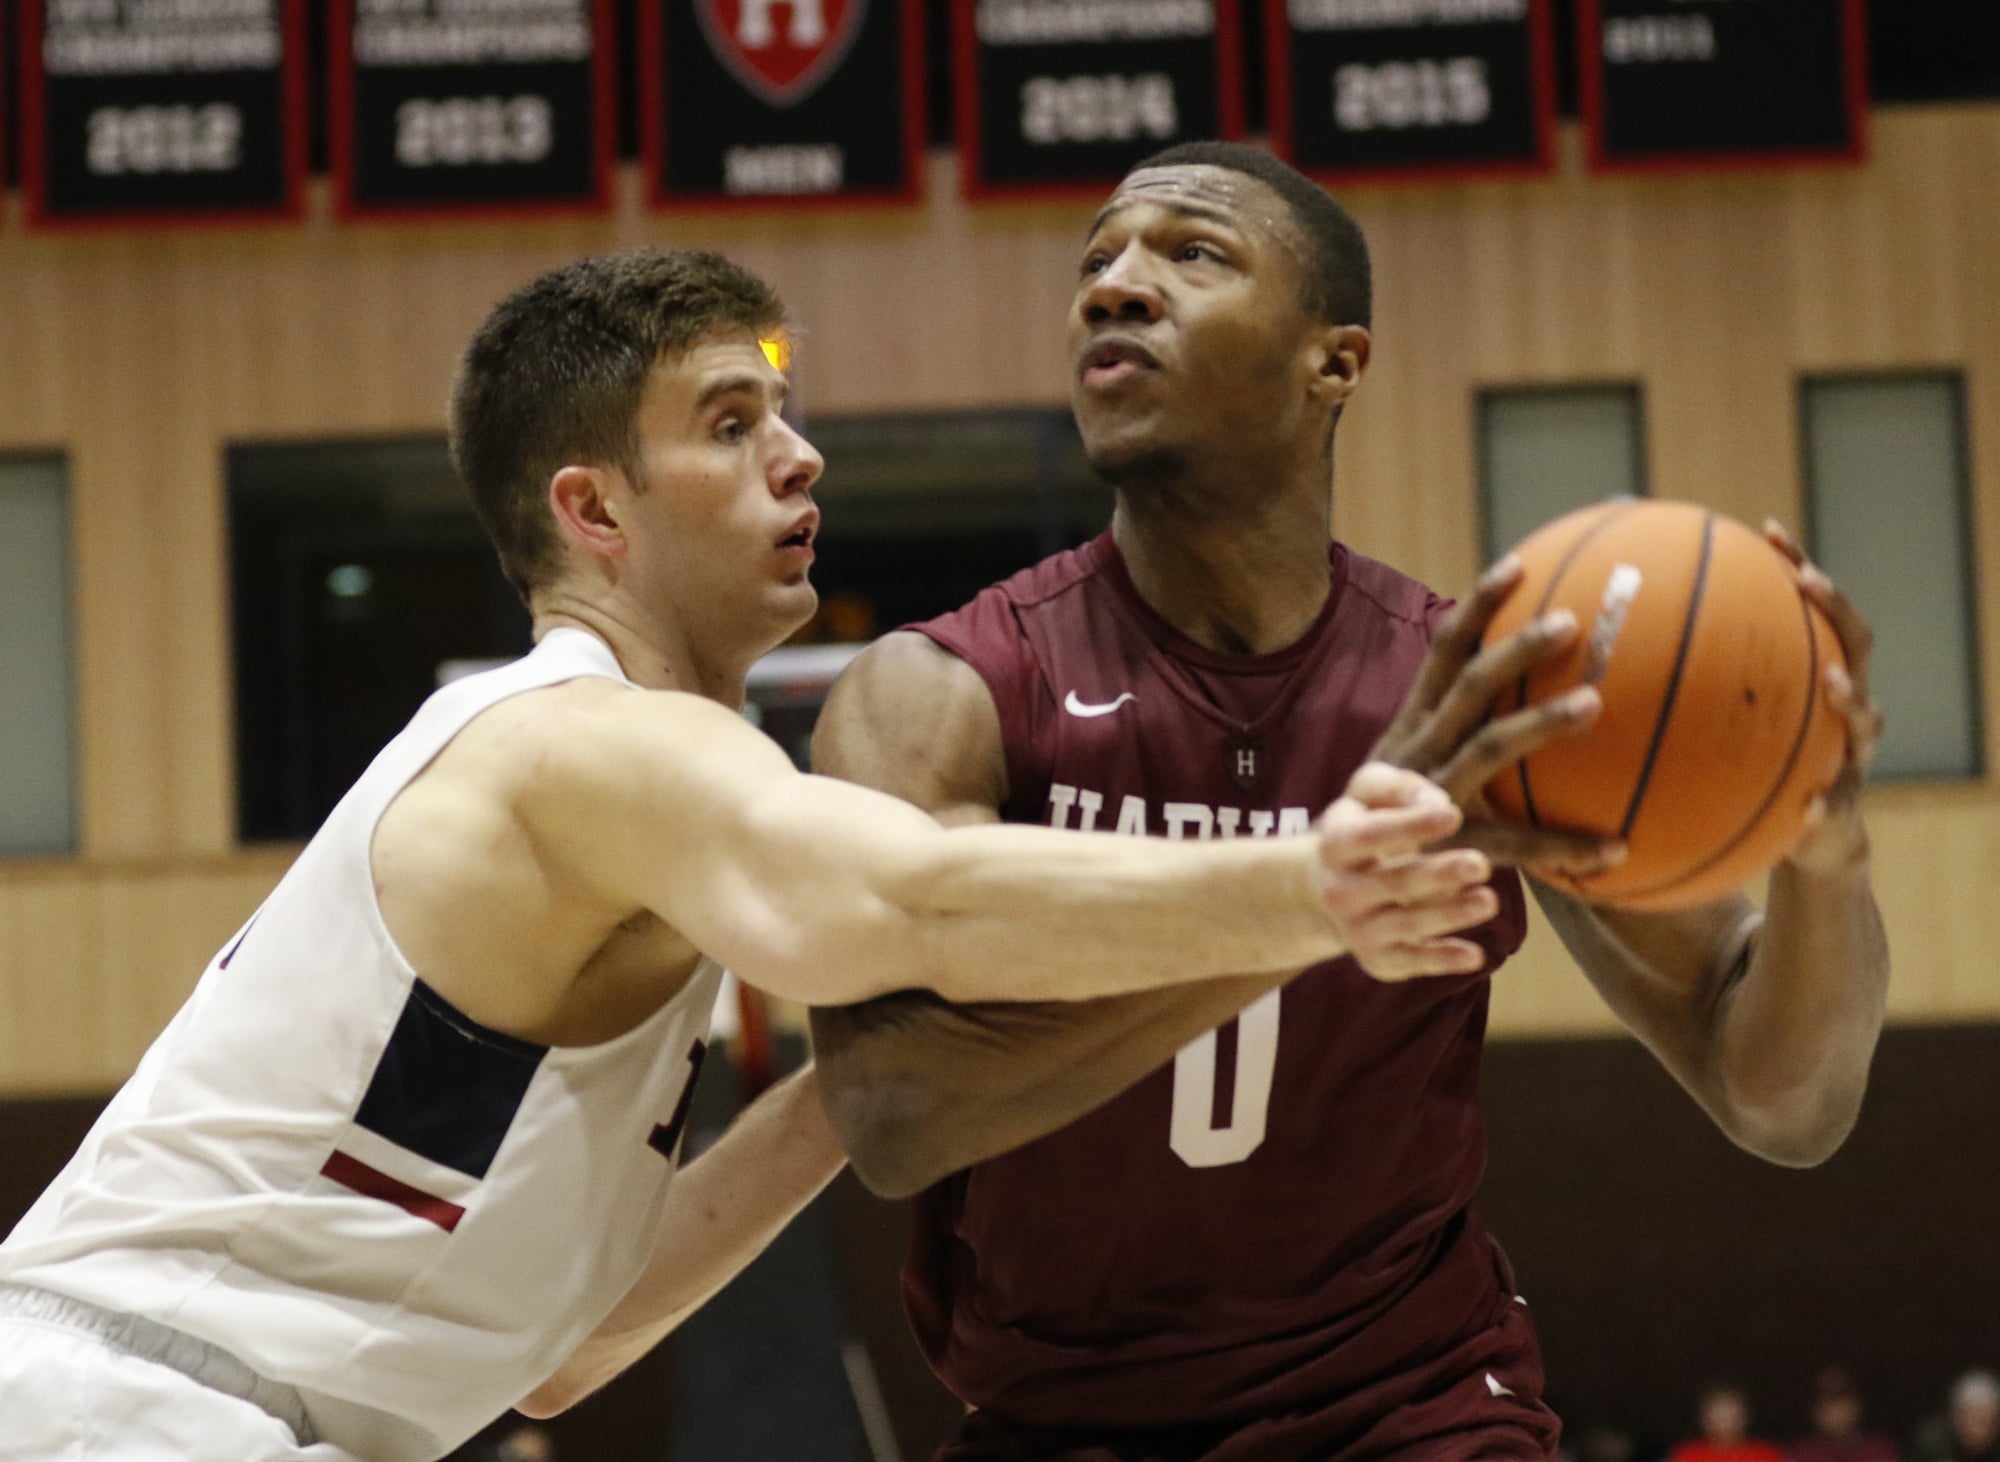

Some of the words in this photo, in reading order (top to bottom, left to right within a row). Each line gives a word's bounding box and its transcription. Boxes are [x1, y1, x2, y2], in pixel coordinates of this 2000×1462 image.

[1022, 75, 1176, 143] 2014
[1334, 58, 1490, 130] 2015
[89, 104, 239, 173] 2012
[397, 97, 550, 165] 2013
[726, 146, 843, 193] MEN
[1236, 749, 1256, 776] H
[1169, 986, 1281, 1168] 0
